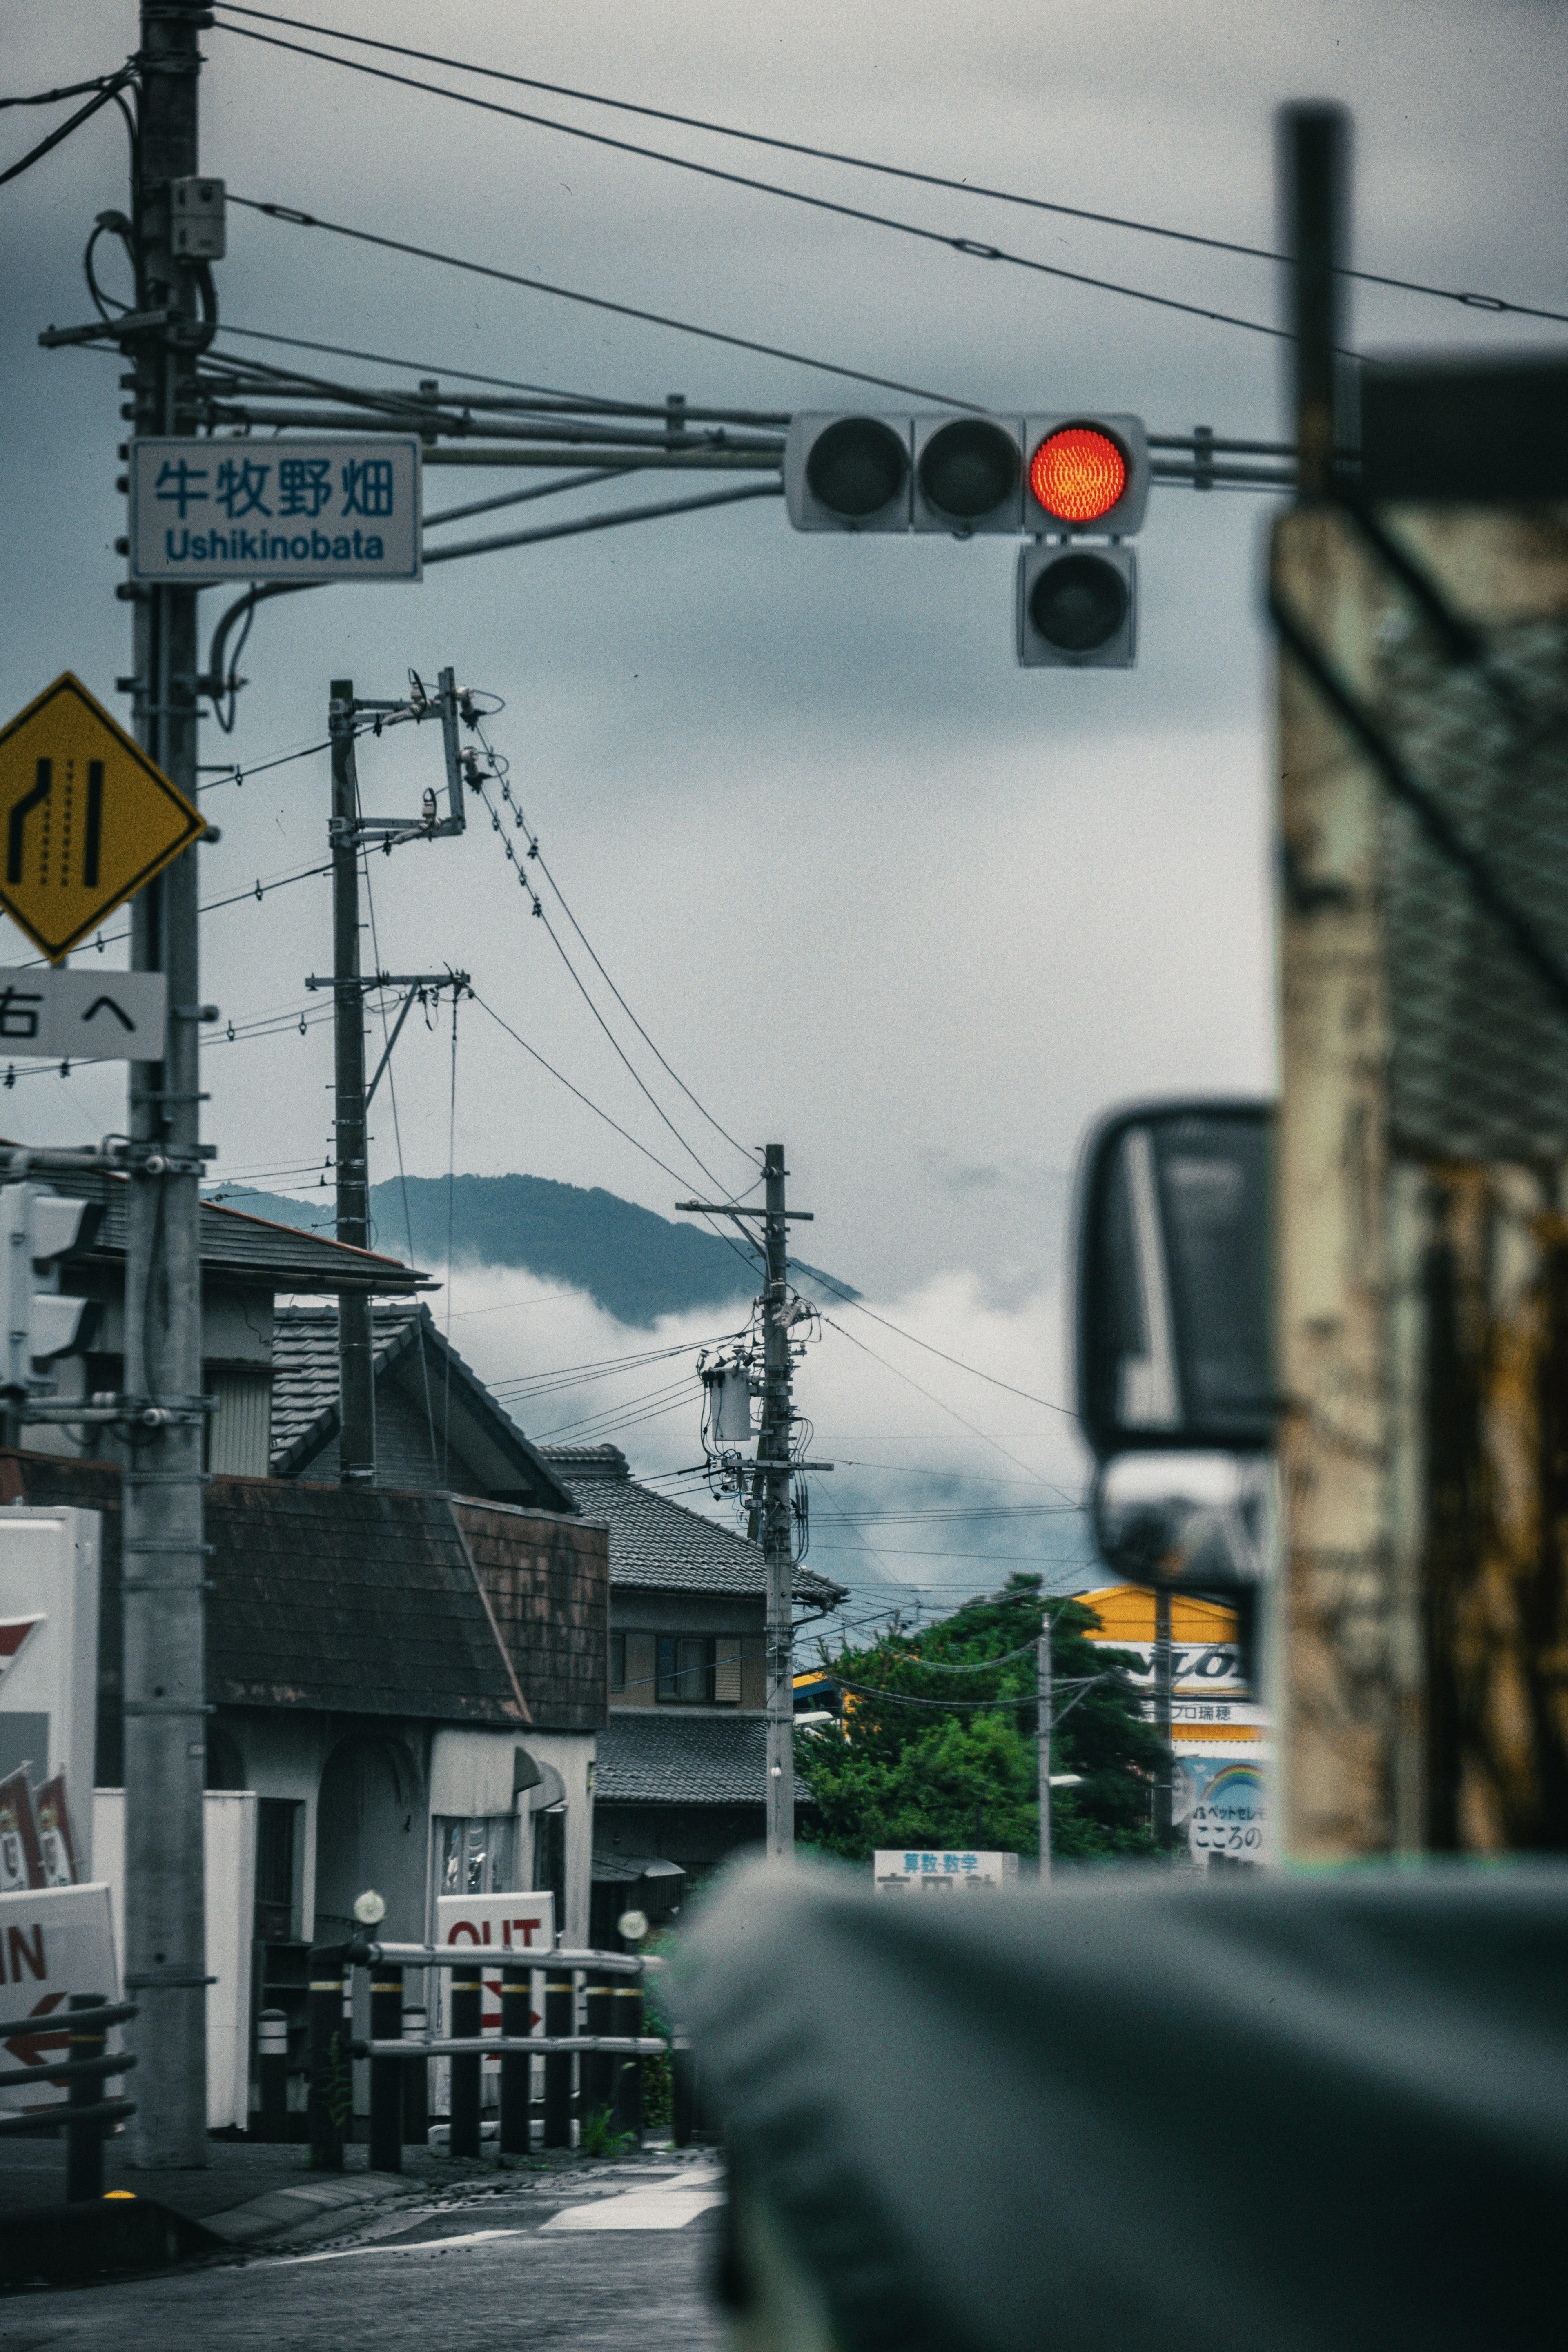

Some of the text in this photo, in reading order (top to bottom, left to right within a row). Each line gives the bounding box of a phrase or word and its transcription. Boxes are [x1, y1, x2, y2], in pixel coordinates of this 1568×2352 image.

[156, 458, 393, 518] 牛牧野畑
[167, 530, 383, 560] Ushikinobata
[0, 985, 136, 1038] 右へ
[1196, 1826, 1262, 1849] こころの
